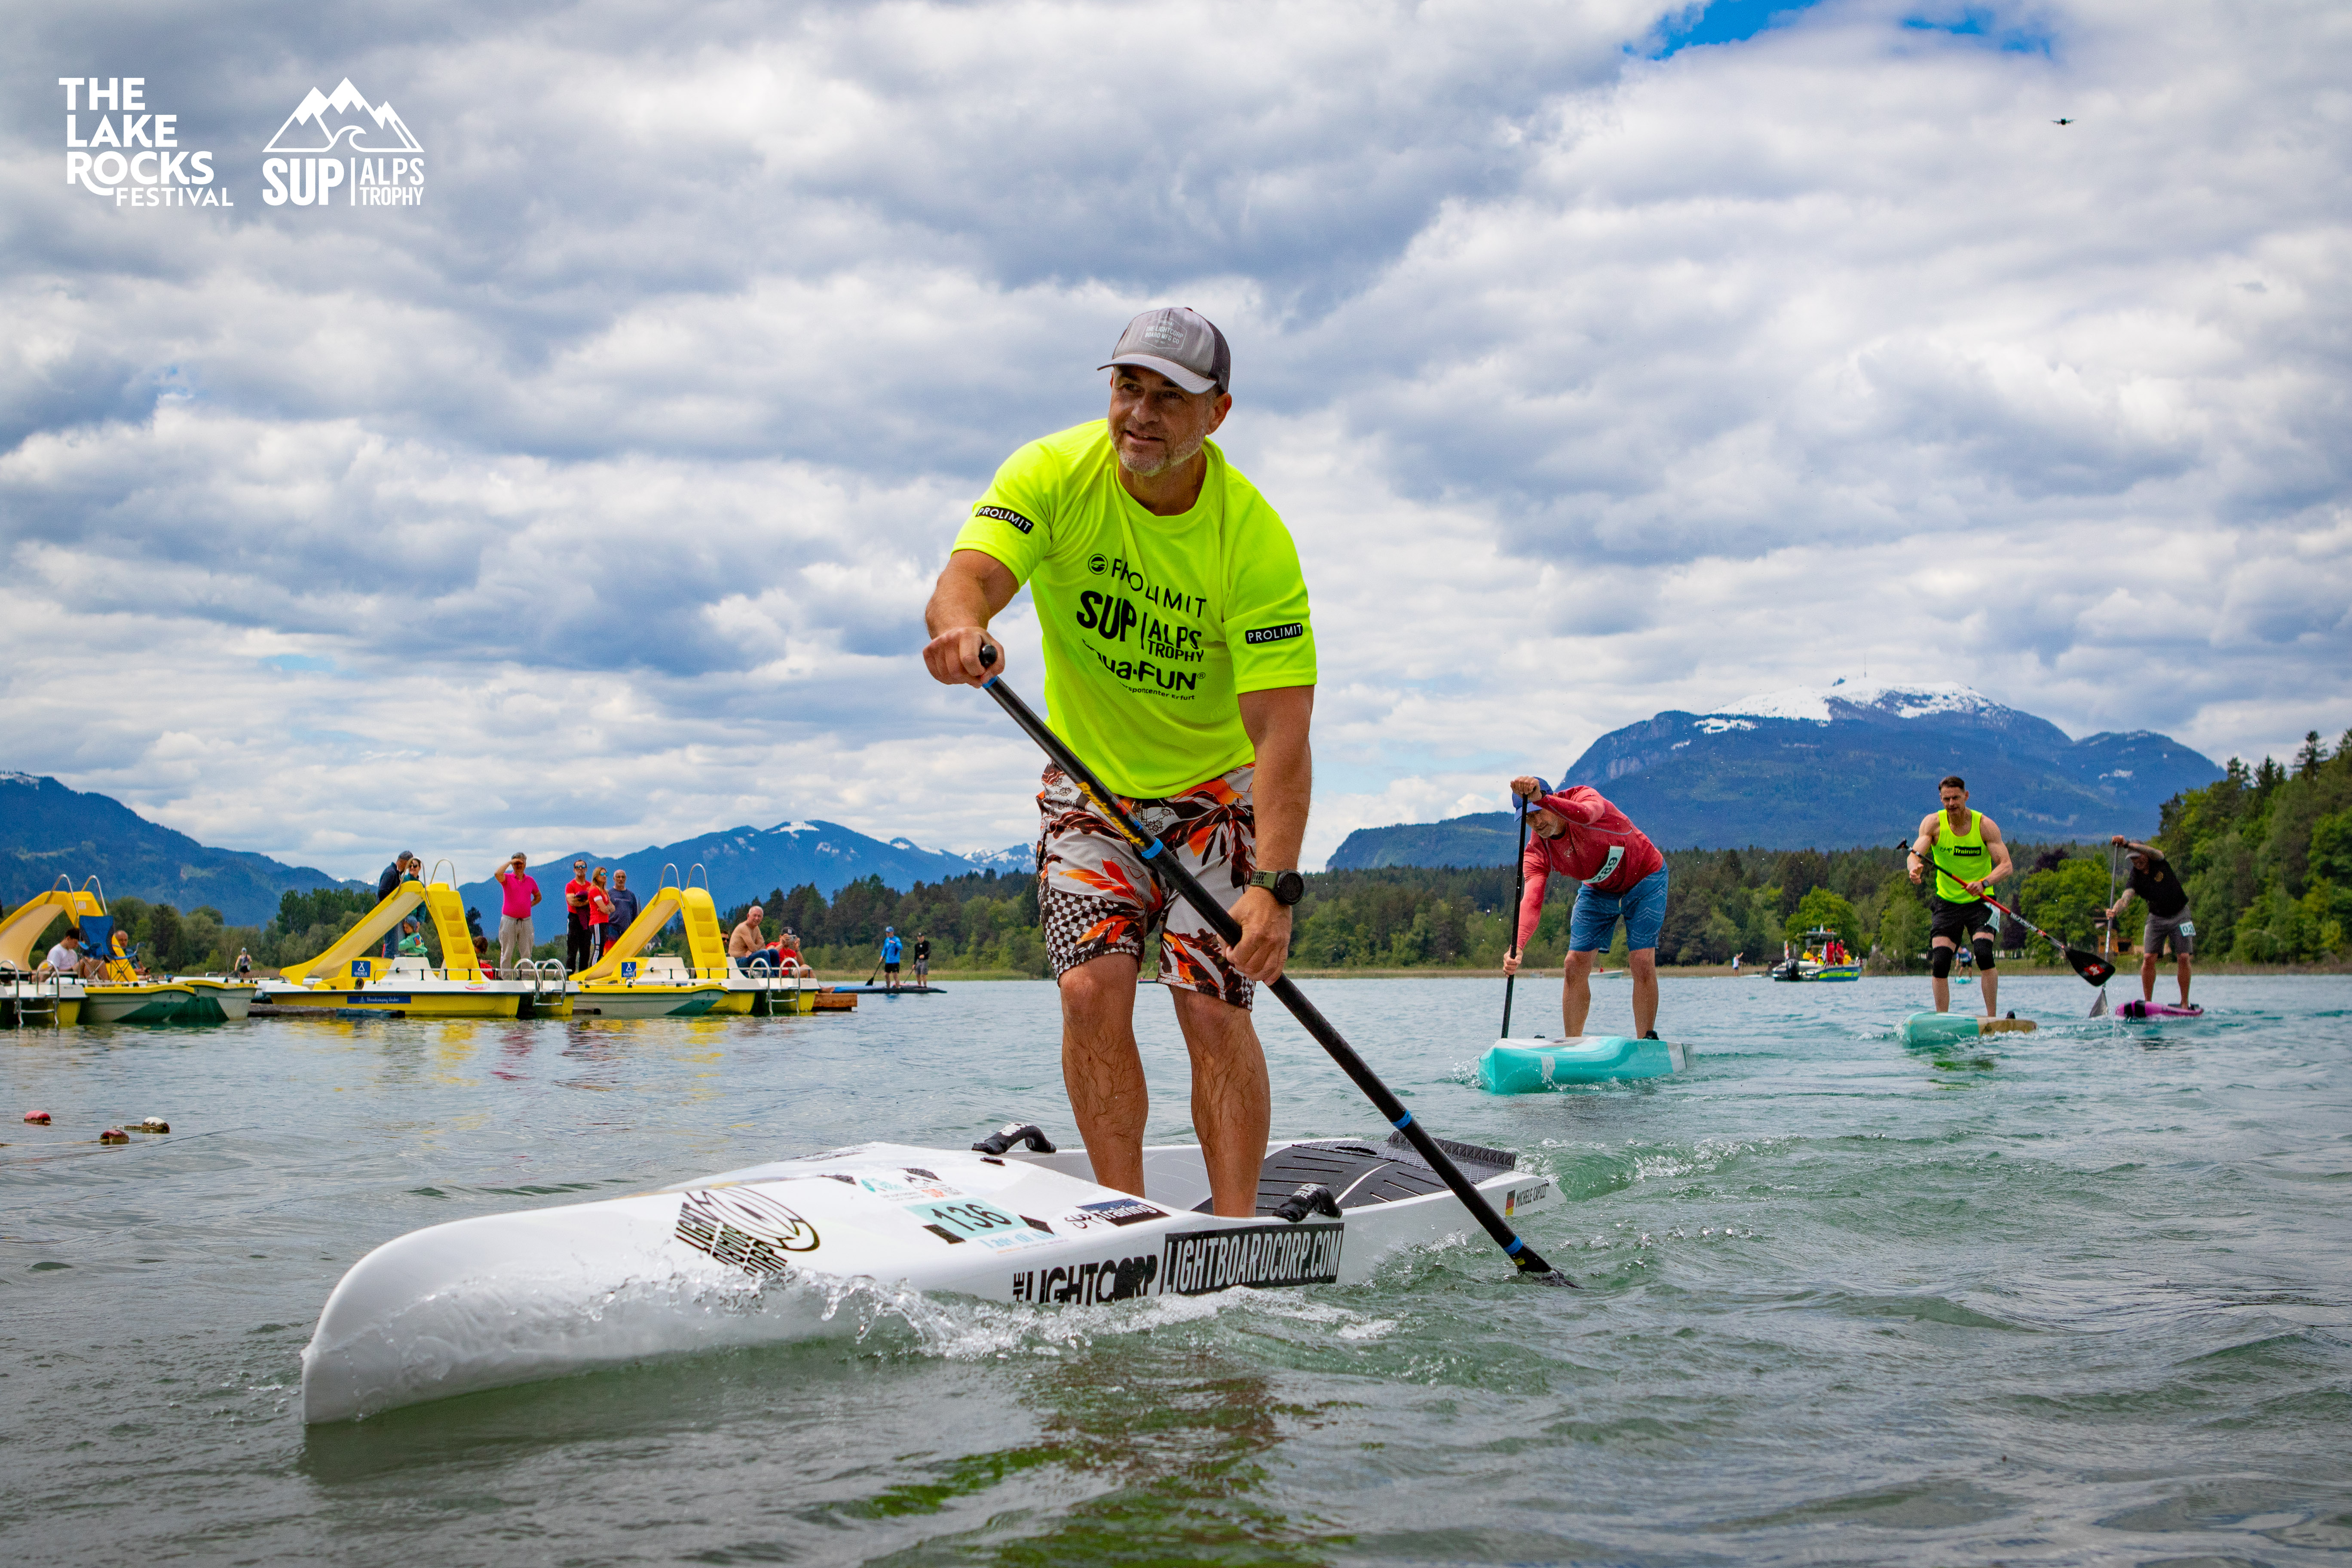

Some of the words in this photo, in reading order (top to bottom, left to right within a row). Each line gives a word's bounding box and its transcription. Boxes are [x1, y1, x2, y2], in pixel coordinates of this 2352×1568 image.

[1155, 326, 1184, 339] LIGHTCORP
[977, 507, 1031, 531] PROLIMIT
[1076, 590, 1137, 642] SUP
[1148, 618, 1202, 650] ALPS
[1248, 624, 1302, 642] PROLIMIT
[1147, 638, 1204, 662] TROPHY
[1592, 856, 1618, 881] 289
[2182, 925, 2196, 934] 02
[1515, 1188, 1533, 1208] MICHELE
[931, 1203, 1012, 1231] 136
[1089, 1204, 1158, 1220] Training
[674, 1202, 720, 1255] LIGHT
[1162, 1230, 1342, 1294] LIGHTBOARDCORP.COM
[1025, 1254, 1158, 1307] LIGHTCORP
